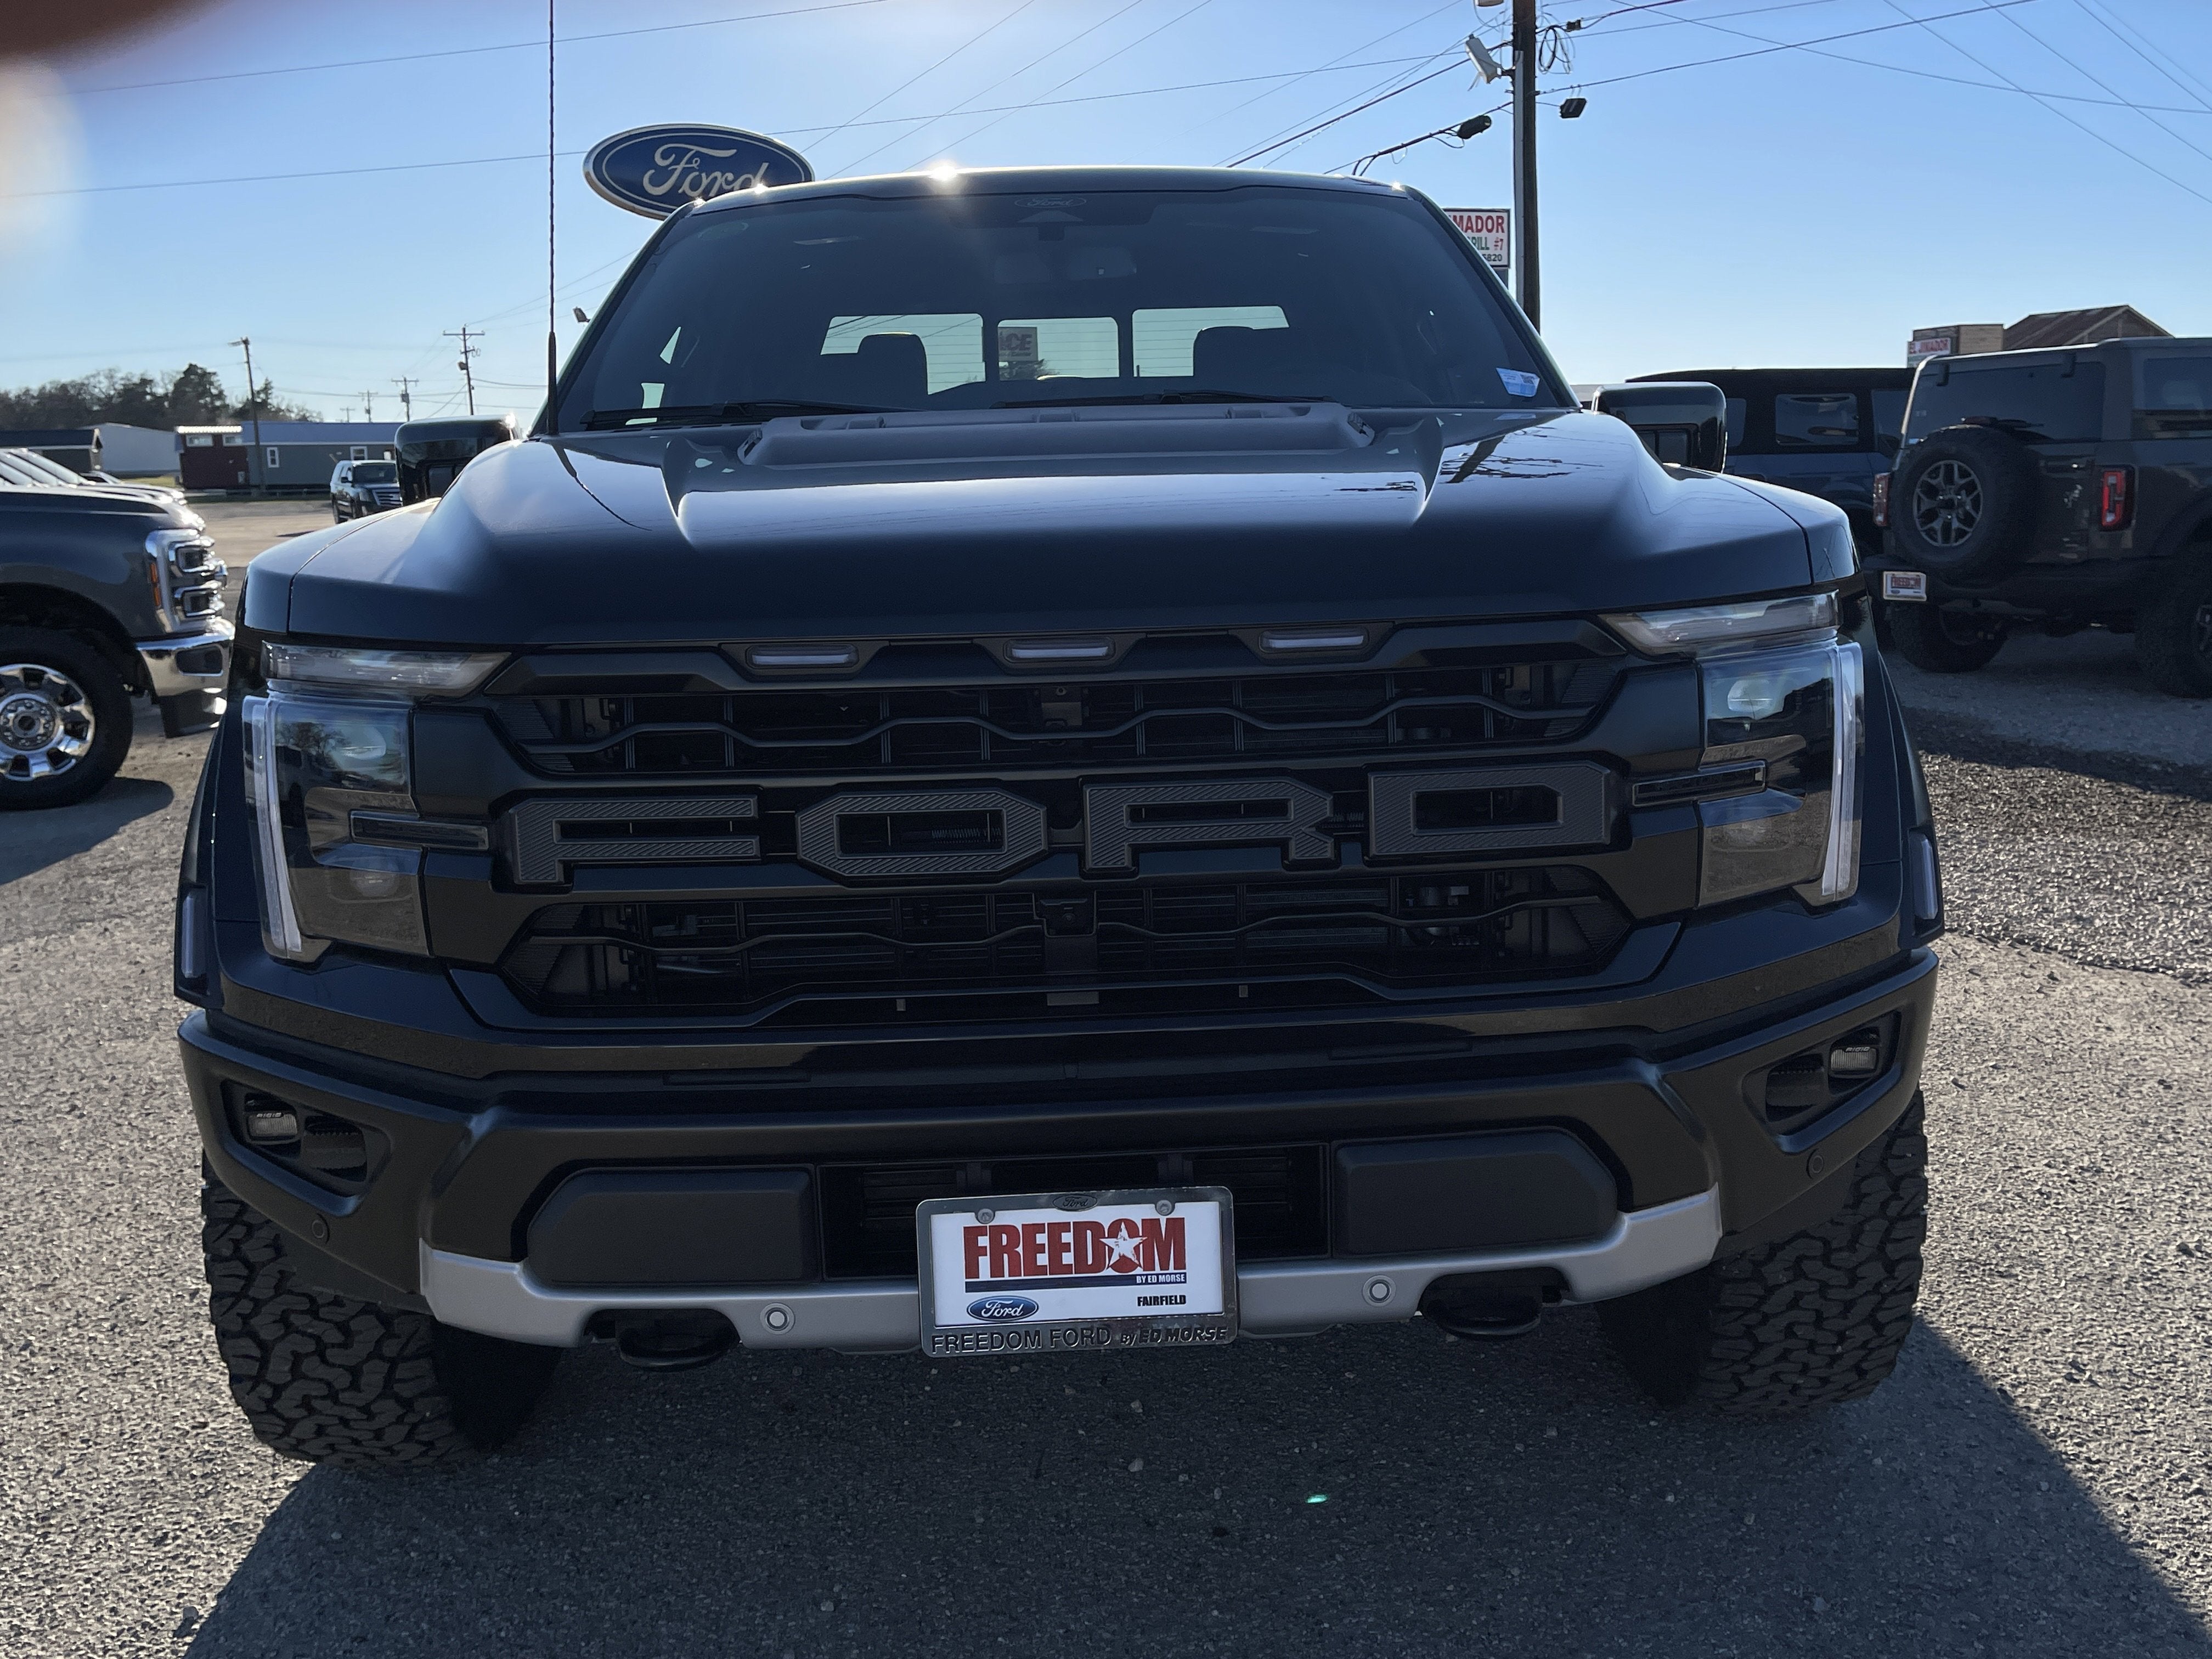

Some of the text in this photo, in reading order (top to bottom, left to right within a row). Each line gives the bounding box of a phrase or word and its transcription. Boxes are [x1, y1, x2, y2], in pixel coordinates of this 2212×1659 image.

[642, 143, 770, 198] Ford
[1449, 215, 1505, 233] MADOR
[508, 760, 1612, 885] FORD
[1062, 1196, 1089, 1207] Ford
[963, 1217, 1187, 1279] FREEDOM
[1136, 1273, 1186, 1283] BY ED MORSE
[981, 1299, 1025, 1317] Ford
[1137, 1294, 1187, 1306] FAIRFIELD
[932, 1329, 1043, 1355] FREEDOM
[1049, 1327, 1112, 1348] FORD
[1138, 1328, 1164, 1344] ED
[1165, 1326, 1229, 1343] MORSE
